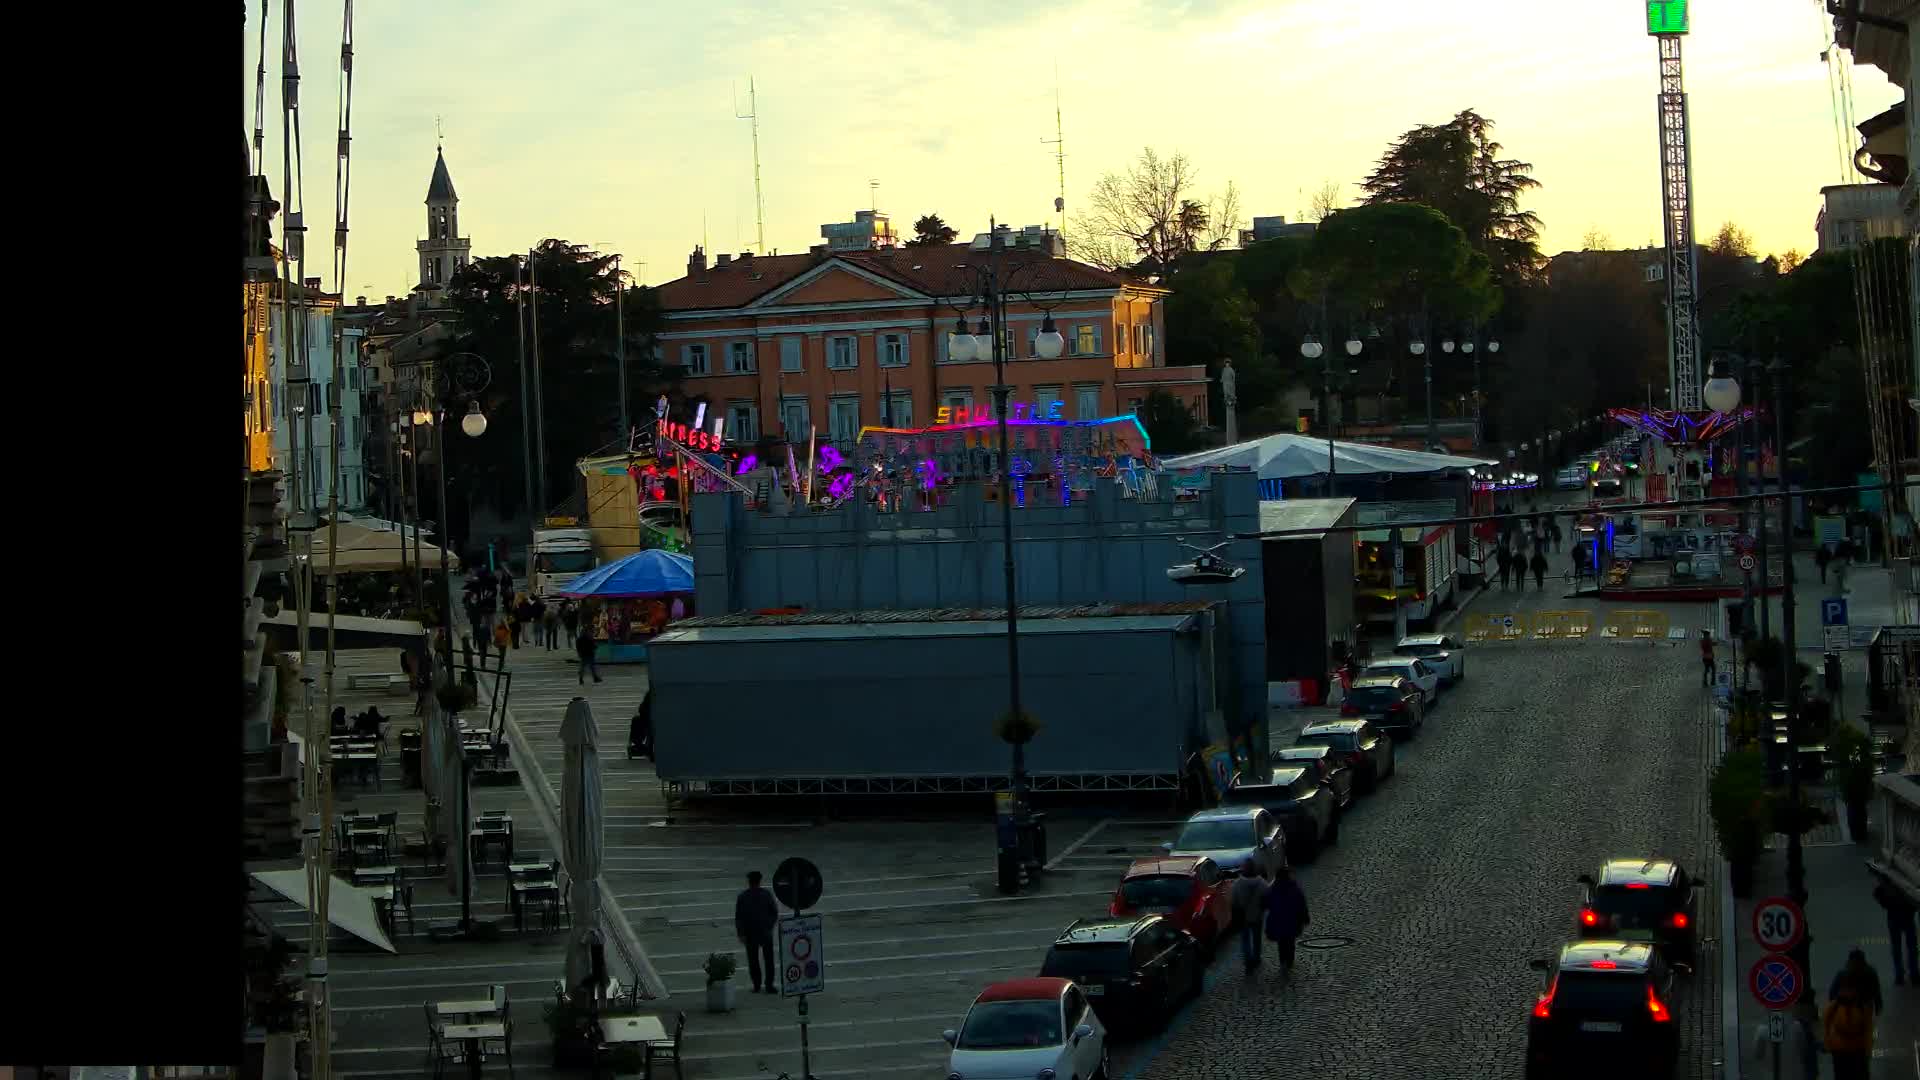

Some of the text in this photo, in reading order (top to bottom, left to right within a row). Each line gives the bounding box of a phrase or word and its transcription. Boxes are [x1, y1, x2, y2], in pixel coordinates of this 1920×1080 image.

[935, 400, 1065, 424] SHUTLE
[1826, 602, 1842, 623] P
[1761, 911, 1791, 938] 30
